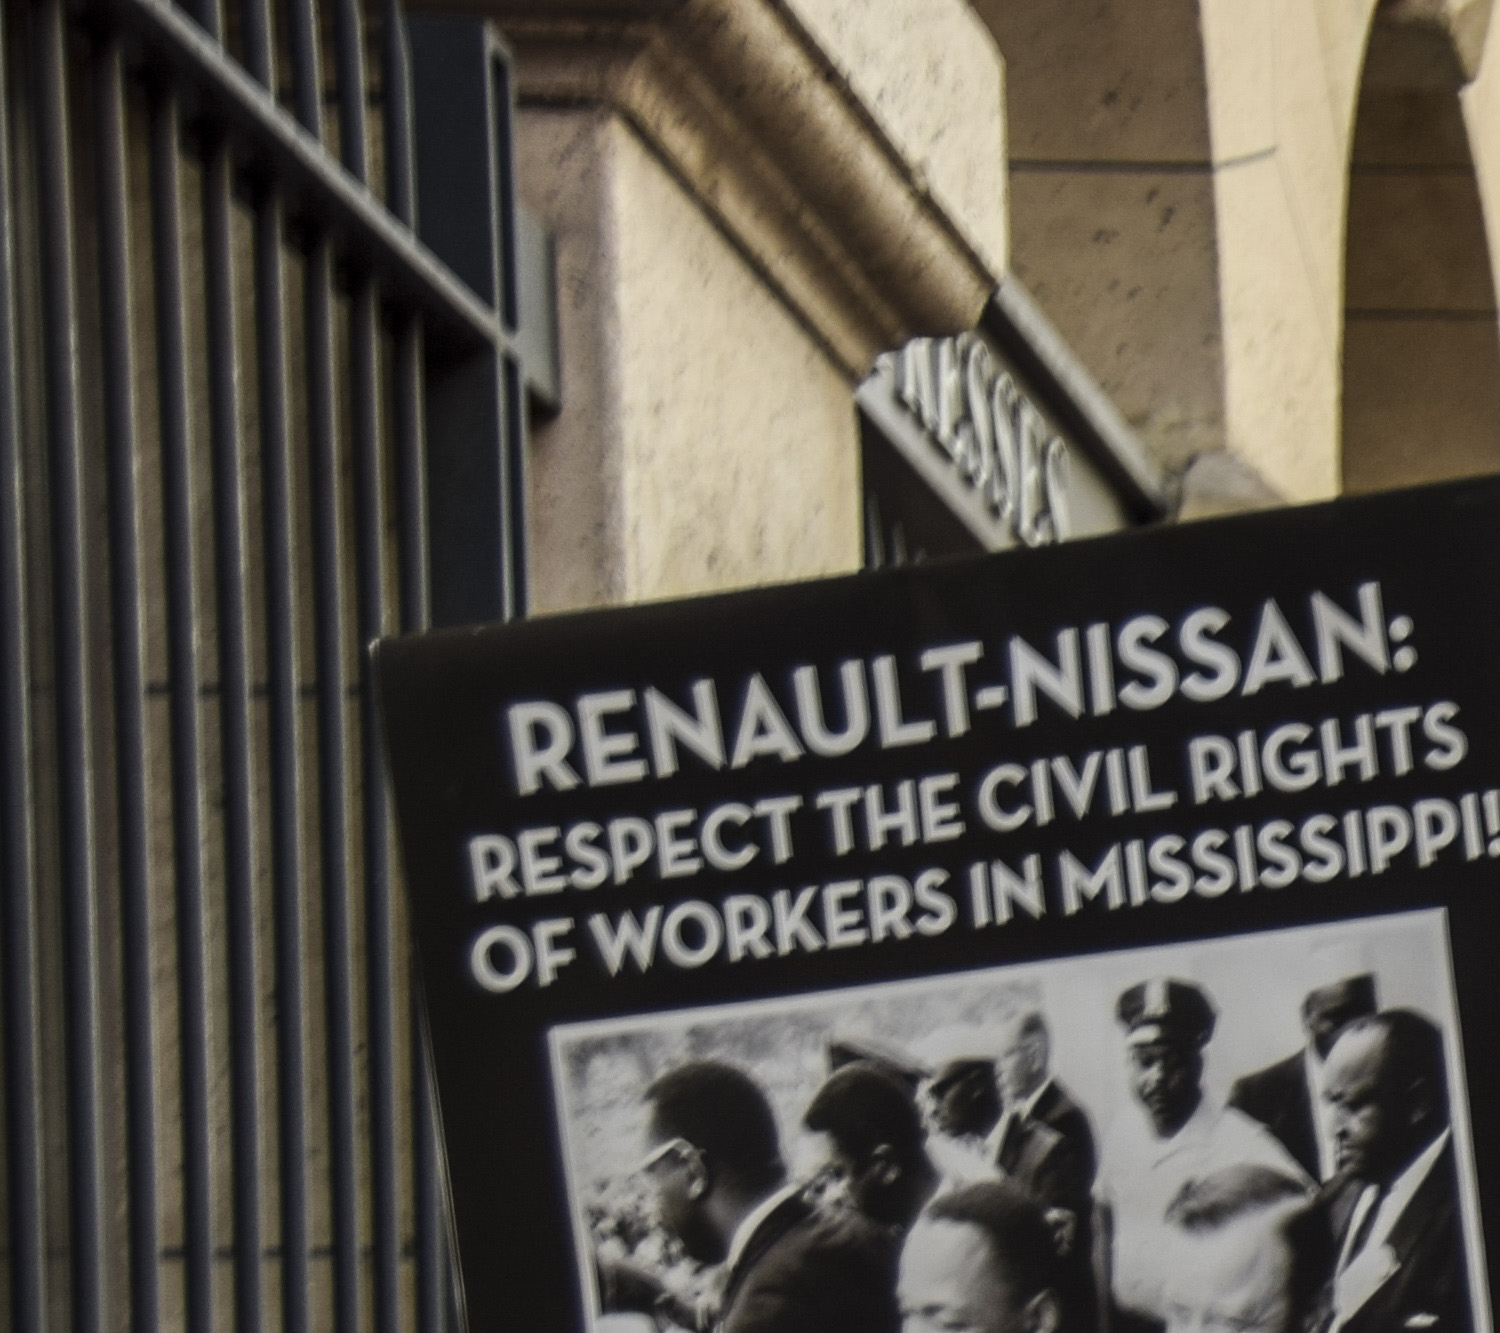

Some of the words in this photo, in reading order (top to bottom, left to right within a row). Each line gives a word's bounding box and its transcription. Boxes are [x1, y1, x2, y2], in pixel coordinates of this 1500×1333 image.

[506, 580, 1420, 797] RENAULT-NISSAN:
[468, 790, 805, 902] RESPECT
[817, 770, 965, 862] THE
[977, 744, 1176, 836] CIVIL
[1188, 702, 1470, 805] RIGHTS
[469, 912, 577, 993] OF
[588, 868, 952, 976] WORKERS
[969, 856, 1042, 928] IN
